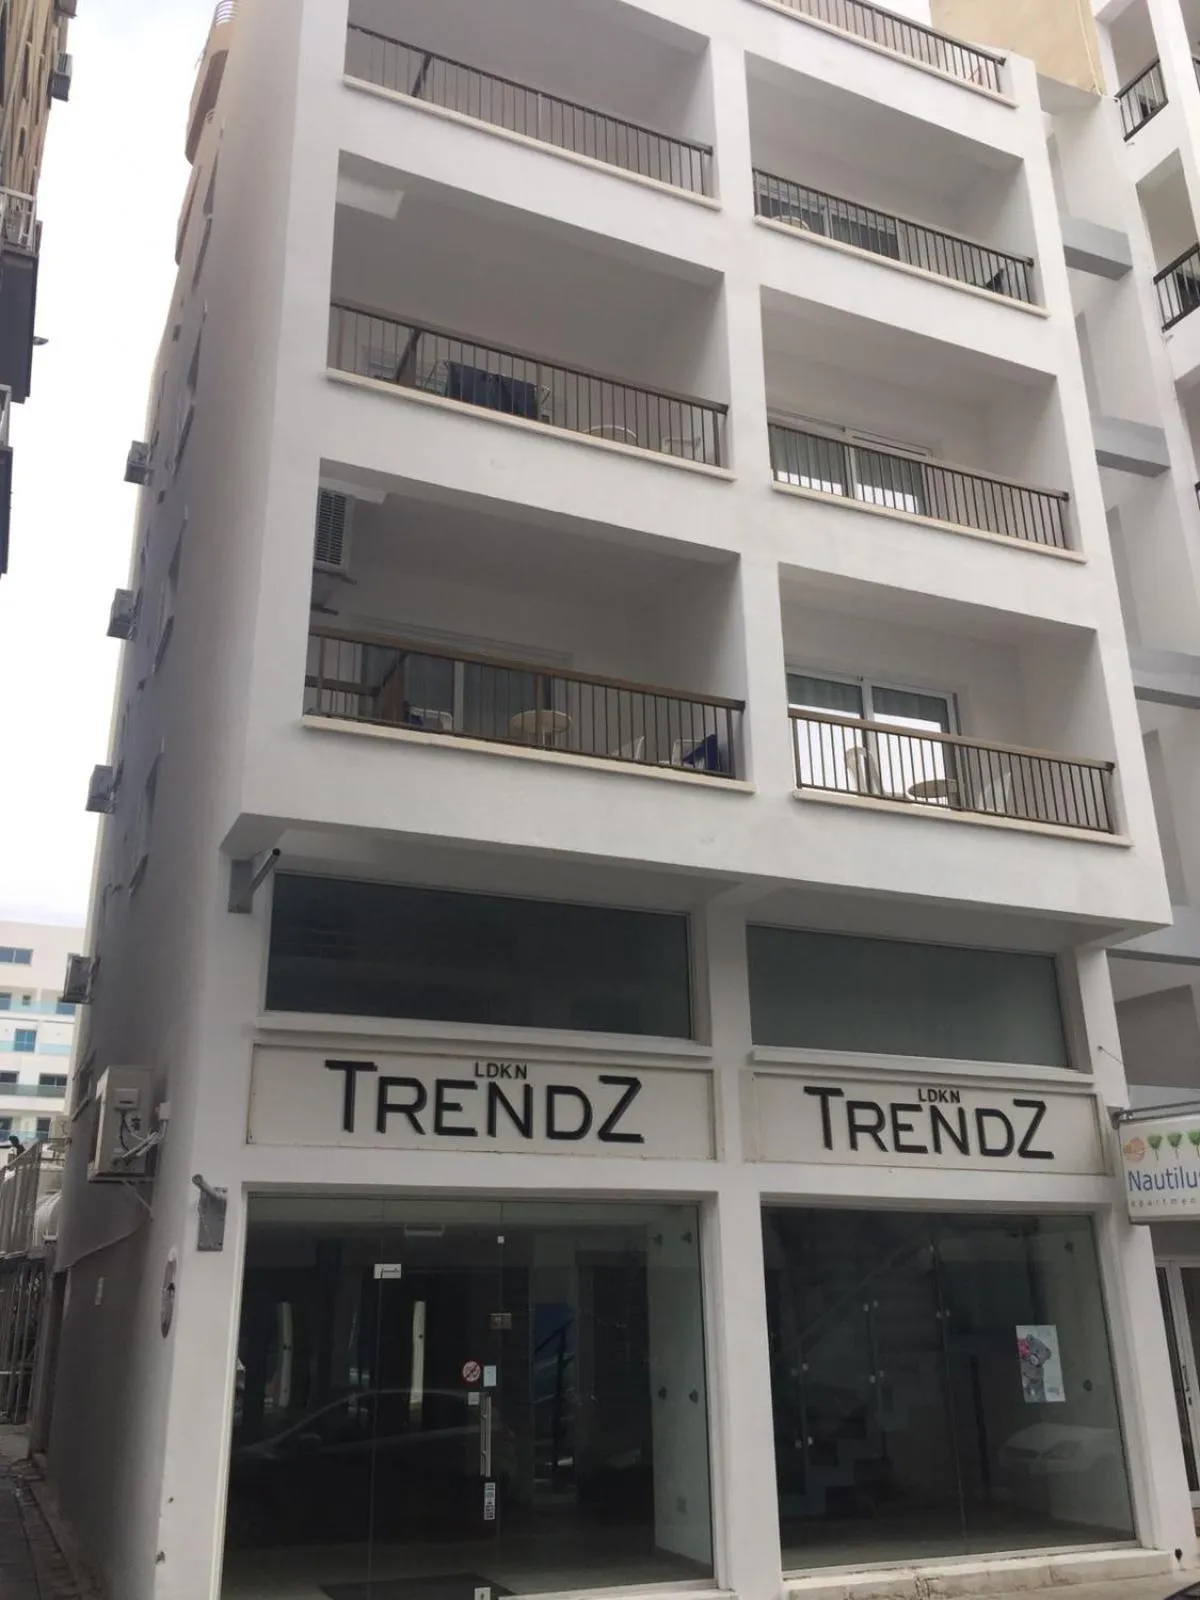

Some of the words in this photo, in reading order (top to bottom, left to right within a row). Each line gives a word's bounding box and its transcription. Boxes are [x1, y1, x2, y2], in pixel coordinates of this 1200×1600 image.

[474, 1062, 527, 1080] LDKN
[324, 1060, 644, 1143] TRENDZ
[917, 1088, 960, 1103] LDKN
[804, 1086, 1054, 1159] TRENDZ
[1128, 1166, 1200, 1191] Nautilu
